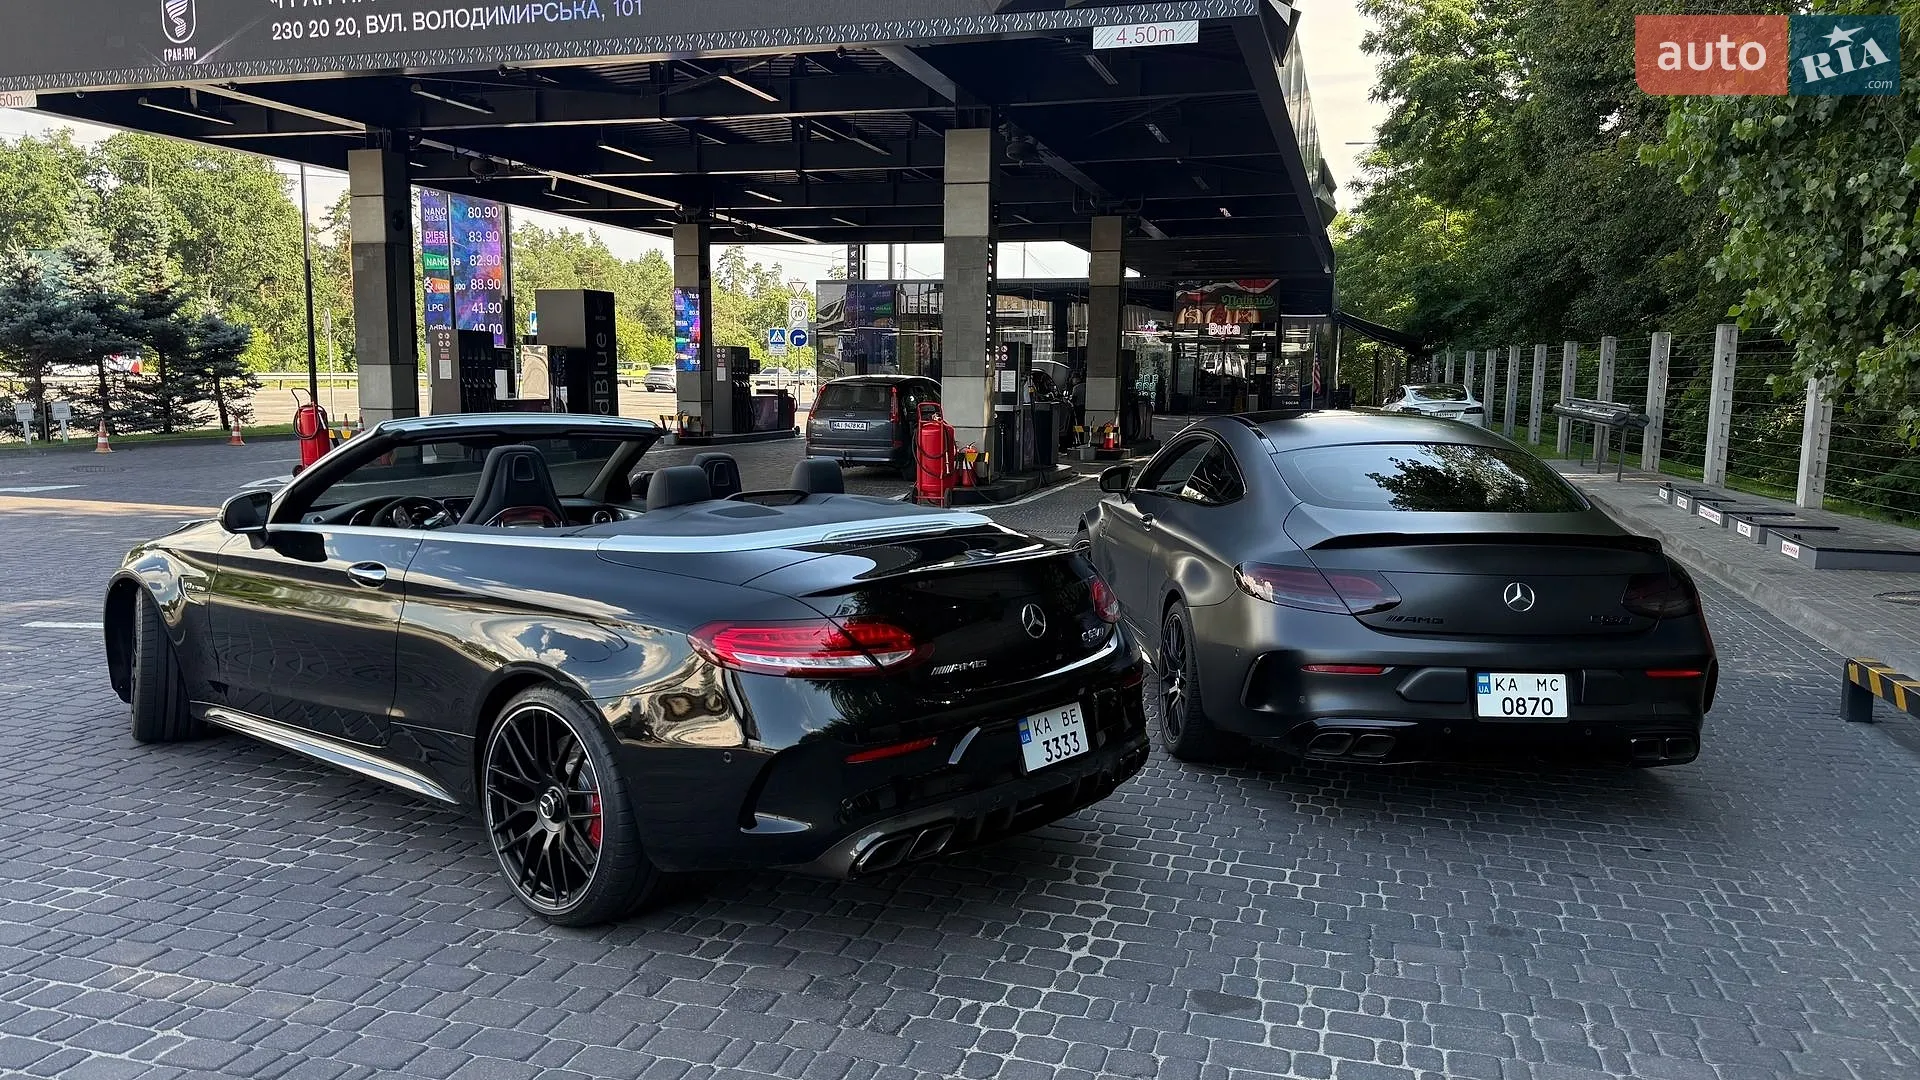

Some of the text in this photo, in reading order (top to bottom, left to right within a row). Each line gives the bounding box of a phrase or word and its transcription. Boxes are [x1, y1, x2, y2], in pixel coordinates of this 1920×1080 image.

[272, 0, 642, 40] 230 20 20, ВУЛ. ВОЛОДИМИРСЬКА, 101
[1116, 27, 1175, 45] 4.50m
[164, 47, 197, 61] ГРАН-ПРІ
[424, 207, 447, 215] NANO
[468, 207, 498, 218] 80.90
[425, 231, 448, 239] DIESE
[469, 231, 499, 242] 83.90
[426, 258, 449, 266] NANO
[470, 255, 500, 266] 82.90
[470, 279, 500, 290] 88.90
[428, 304, 443, 312] LPG
[472, 302, 502, 313] 41.90
[795, 311, 803, 319] 10
[1208, 323, 1241, 336] Buta
[593, 333, 610, 414] dBlue
[1402, 617, 1444, 625] AMG
[1495, 678, 1518, 691] KA
[1536, 678, 1559, 692] MC
[1502, 697, 1554, 715] 0870
[1033, 708, 1078, 736] KA BE
[1042, 731, 1080, 762] 3333
